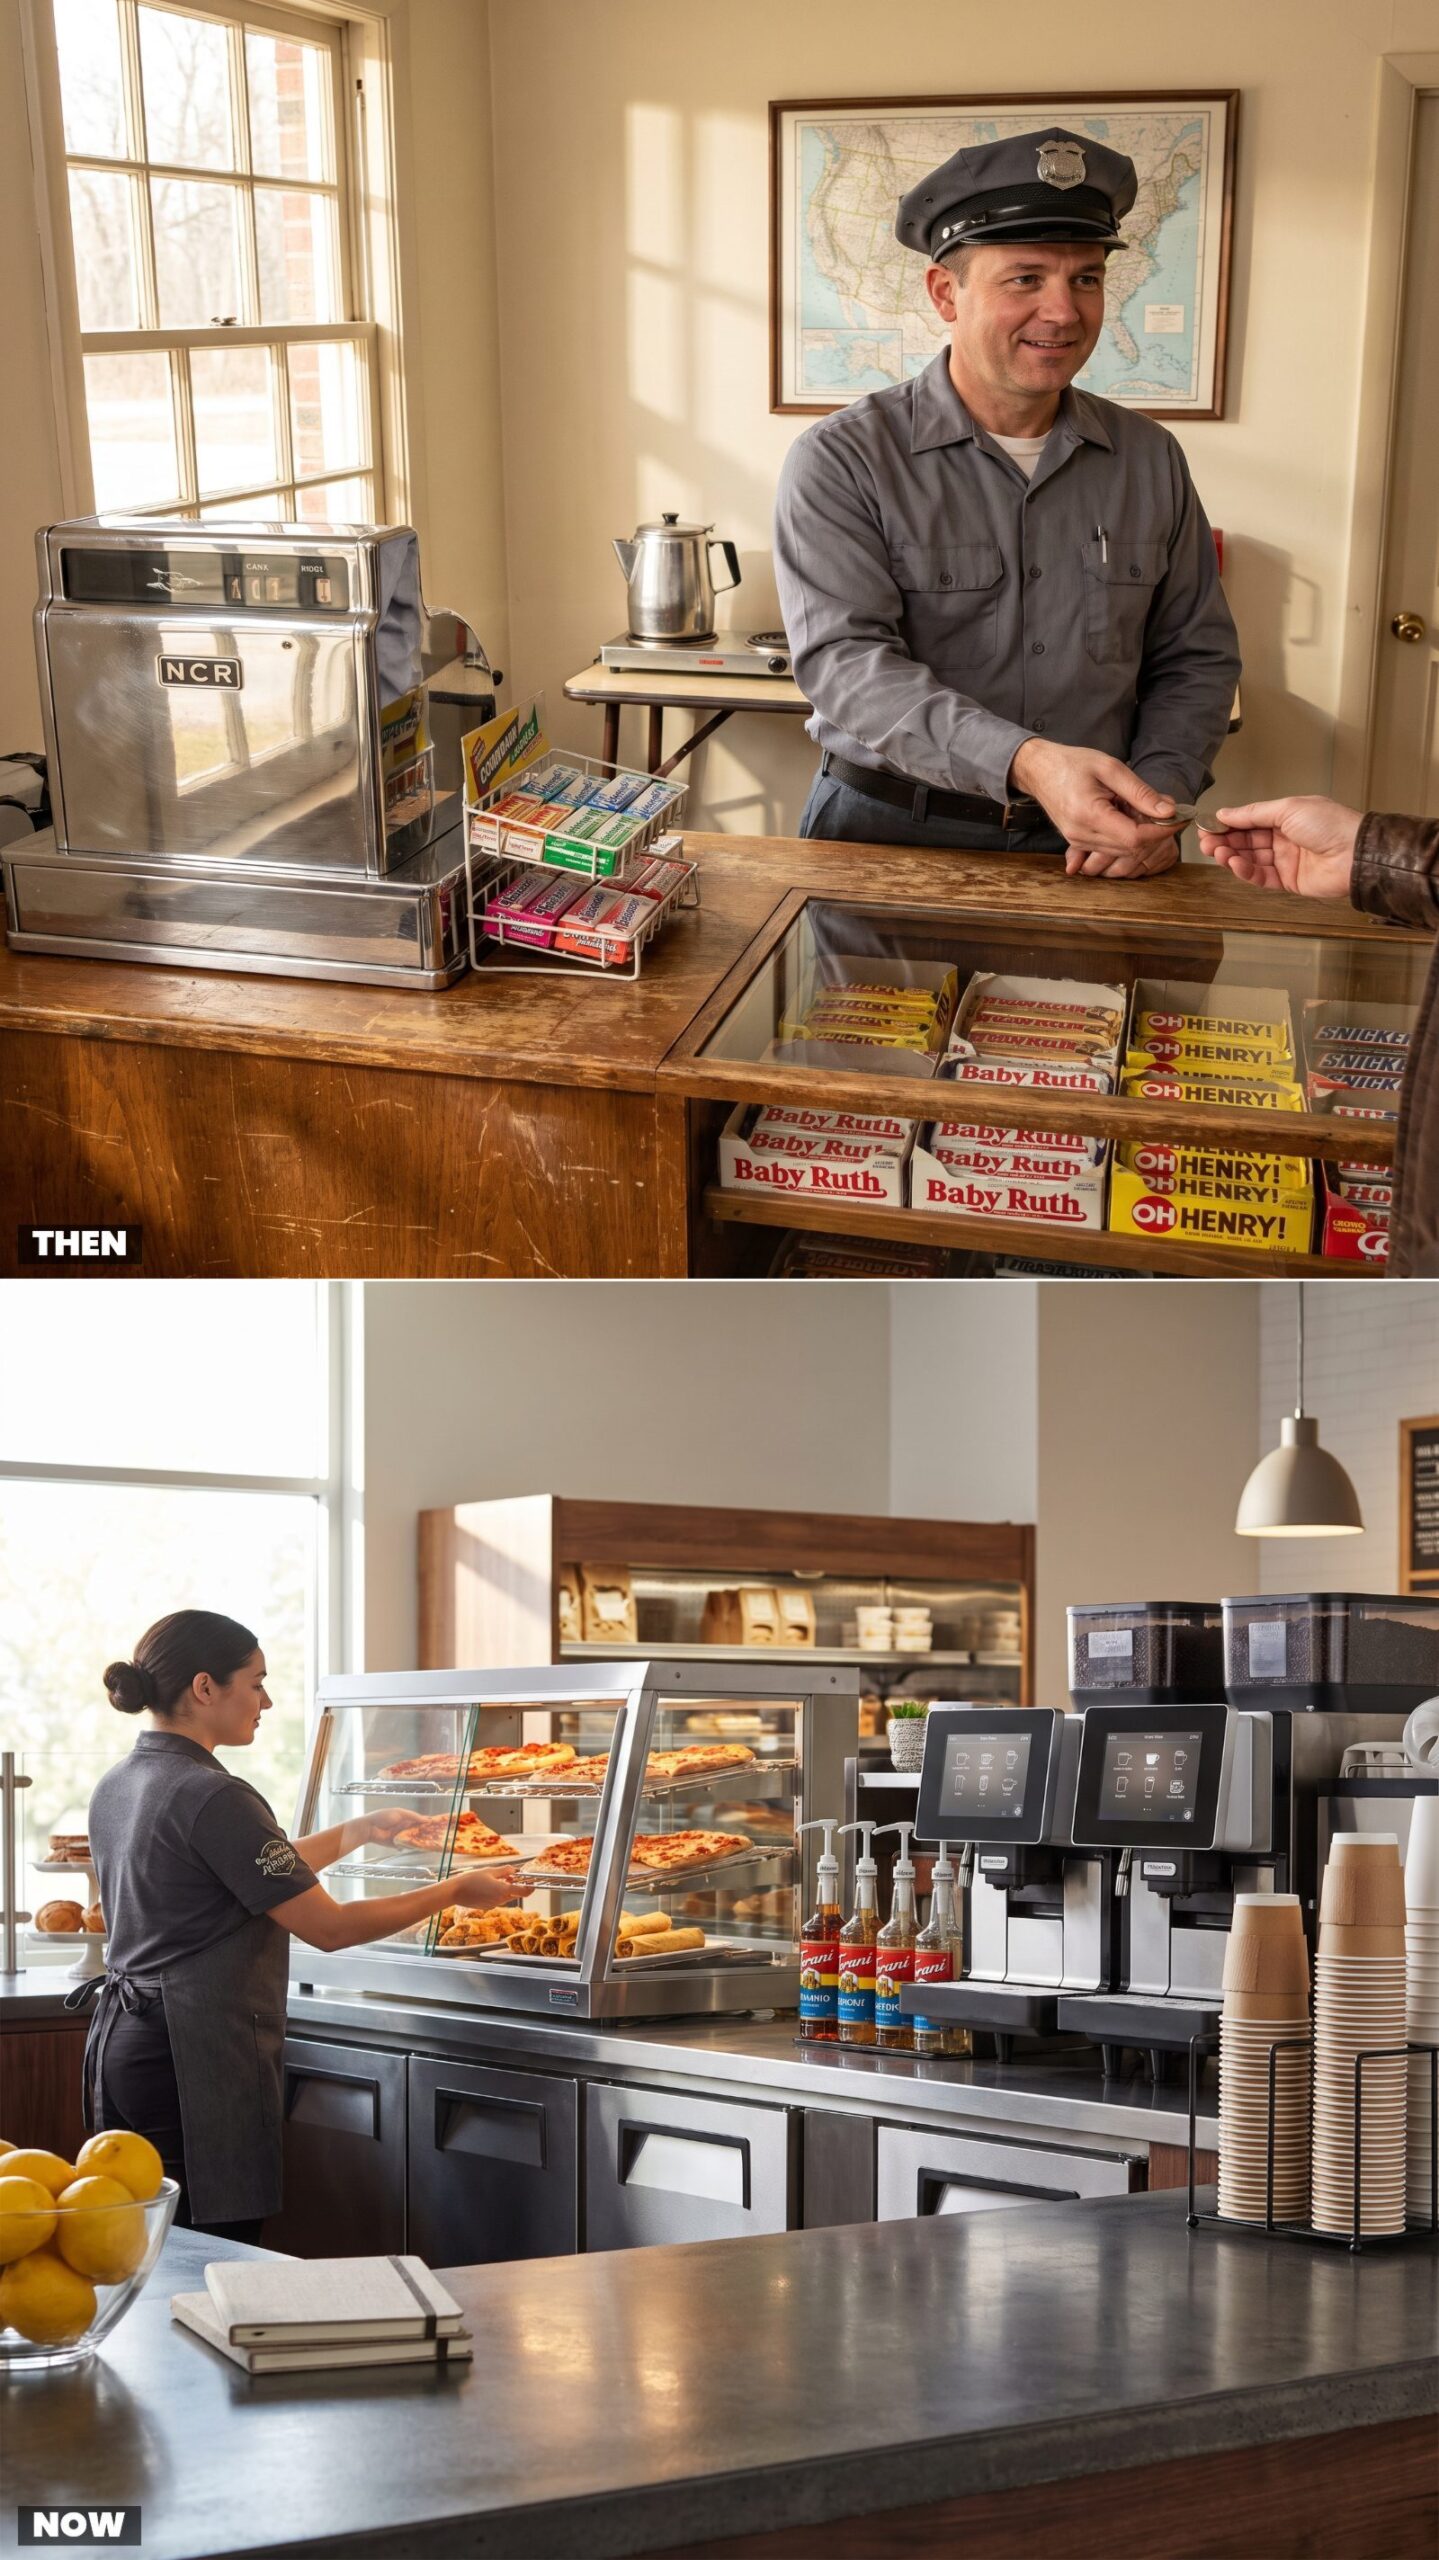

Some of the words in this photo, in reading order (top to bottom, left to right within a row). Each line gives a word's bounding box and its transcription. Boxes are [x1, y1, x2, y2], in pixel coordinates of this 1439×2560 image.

[166, 662, 232, 683] NCR
[1148, 1015, 1183, 1028] OH
[1187, 1018, 1272, 1038] HENRY!
[1144, 1042, 1180, 1056] OH
[1185, 1044, 1272, 1065] HENRY!
[960, 1064, 1029, 1086] Baby
[1033, 1070, 1098, 1089] Ruth
[1141, 1083, 1180, 1098] OH
[1185, 1086, 1277, 1108] HENRY!
[763, 1107, 832, 1130] Baby
[835, 1114, 902, 1134] Ruth
[749, 1132, 820, 1156] Baby
[822, 1139, 885, 1158] Rut
[939, 1122, 1011, 1145] Baby
[1014, 1128, 1084, 1147] Ruth
[734, 1157, 806, 1190] Baby
[810, 1165, 882, 1192] Ruth
[935, 1148, 1008, 1175] Baby
[1010, 1155, 1082, 1176] Ruth
[1134, 1152, 1176, 1172] OH
[1180, 1154, 1280, 1184] HENRY!
[926, 1178, 1003, 1213] Baby
[1007, 1187, 1081, 1215] Ruth
[1179, 1177, 1278, 1204] HENRY!
[1132, 1203, 1176, 1226] OH
[1180, 1207, 1286, 1240] HENRY!
